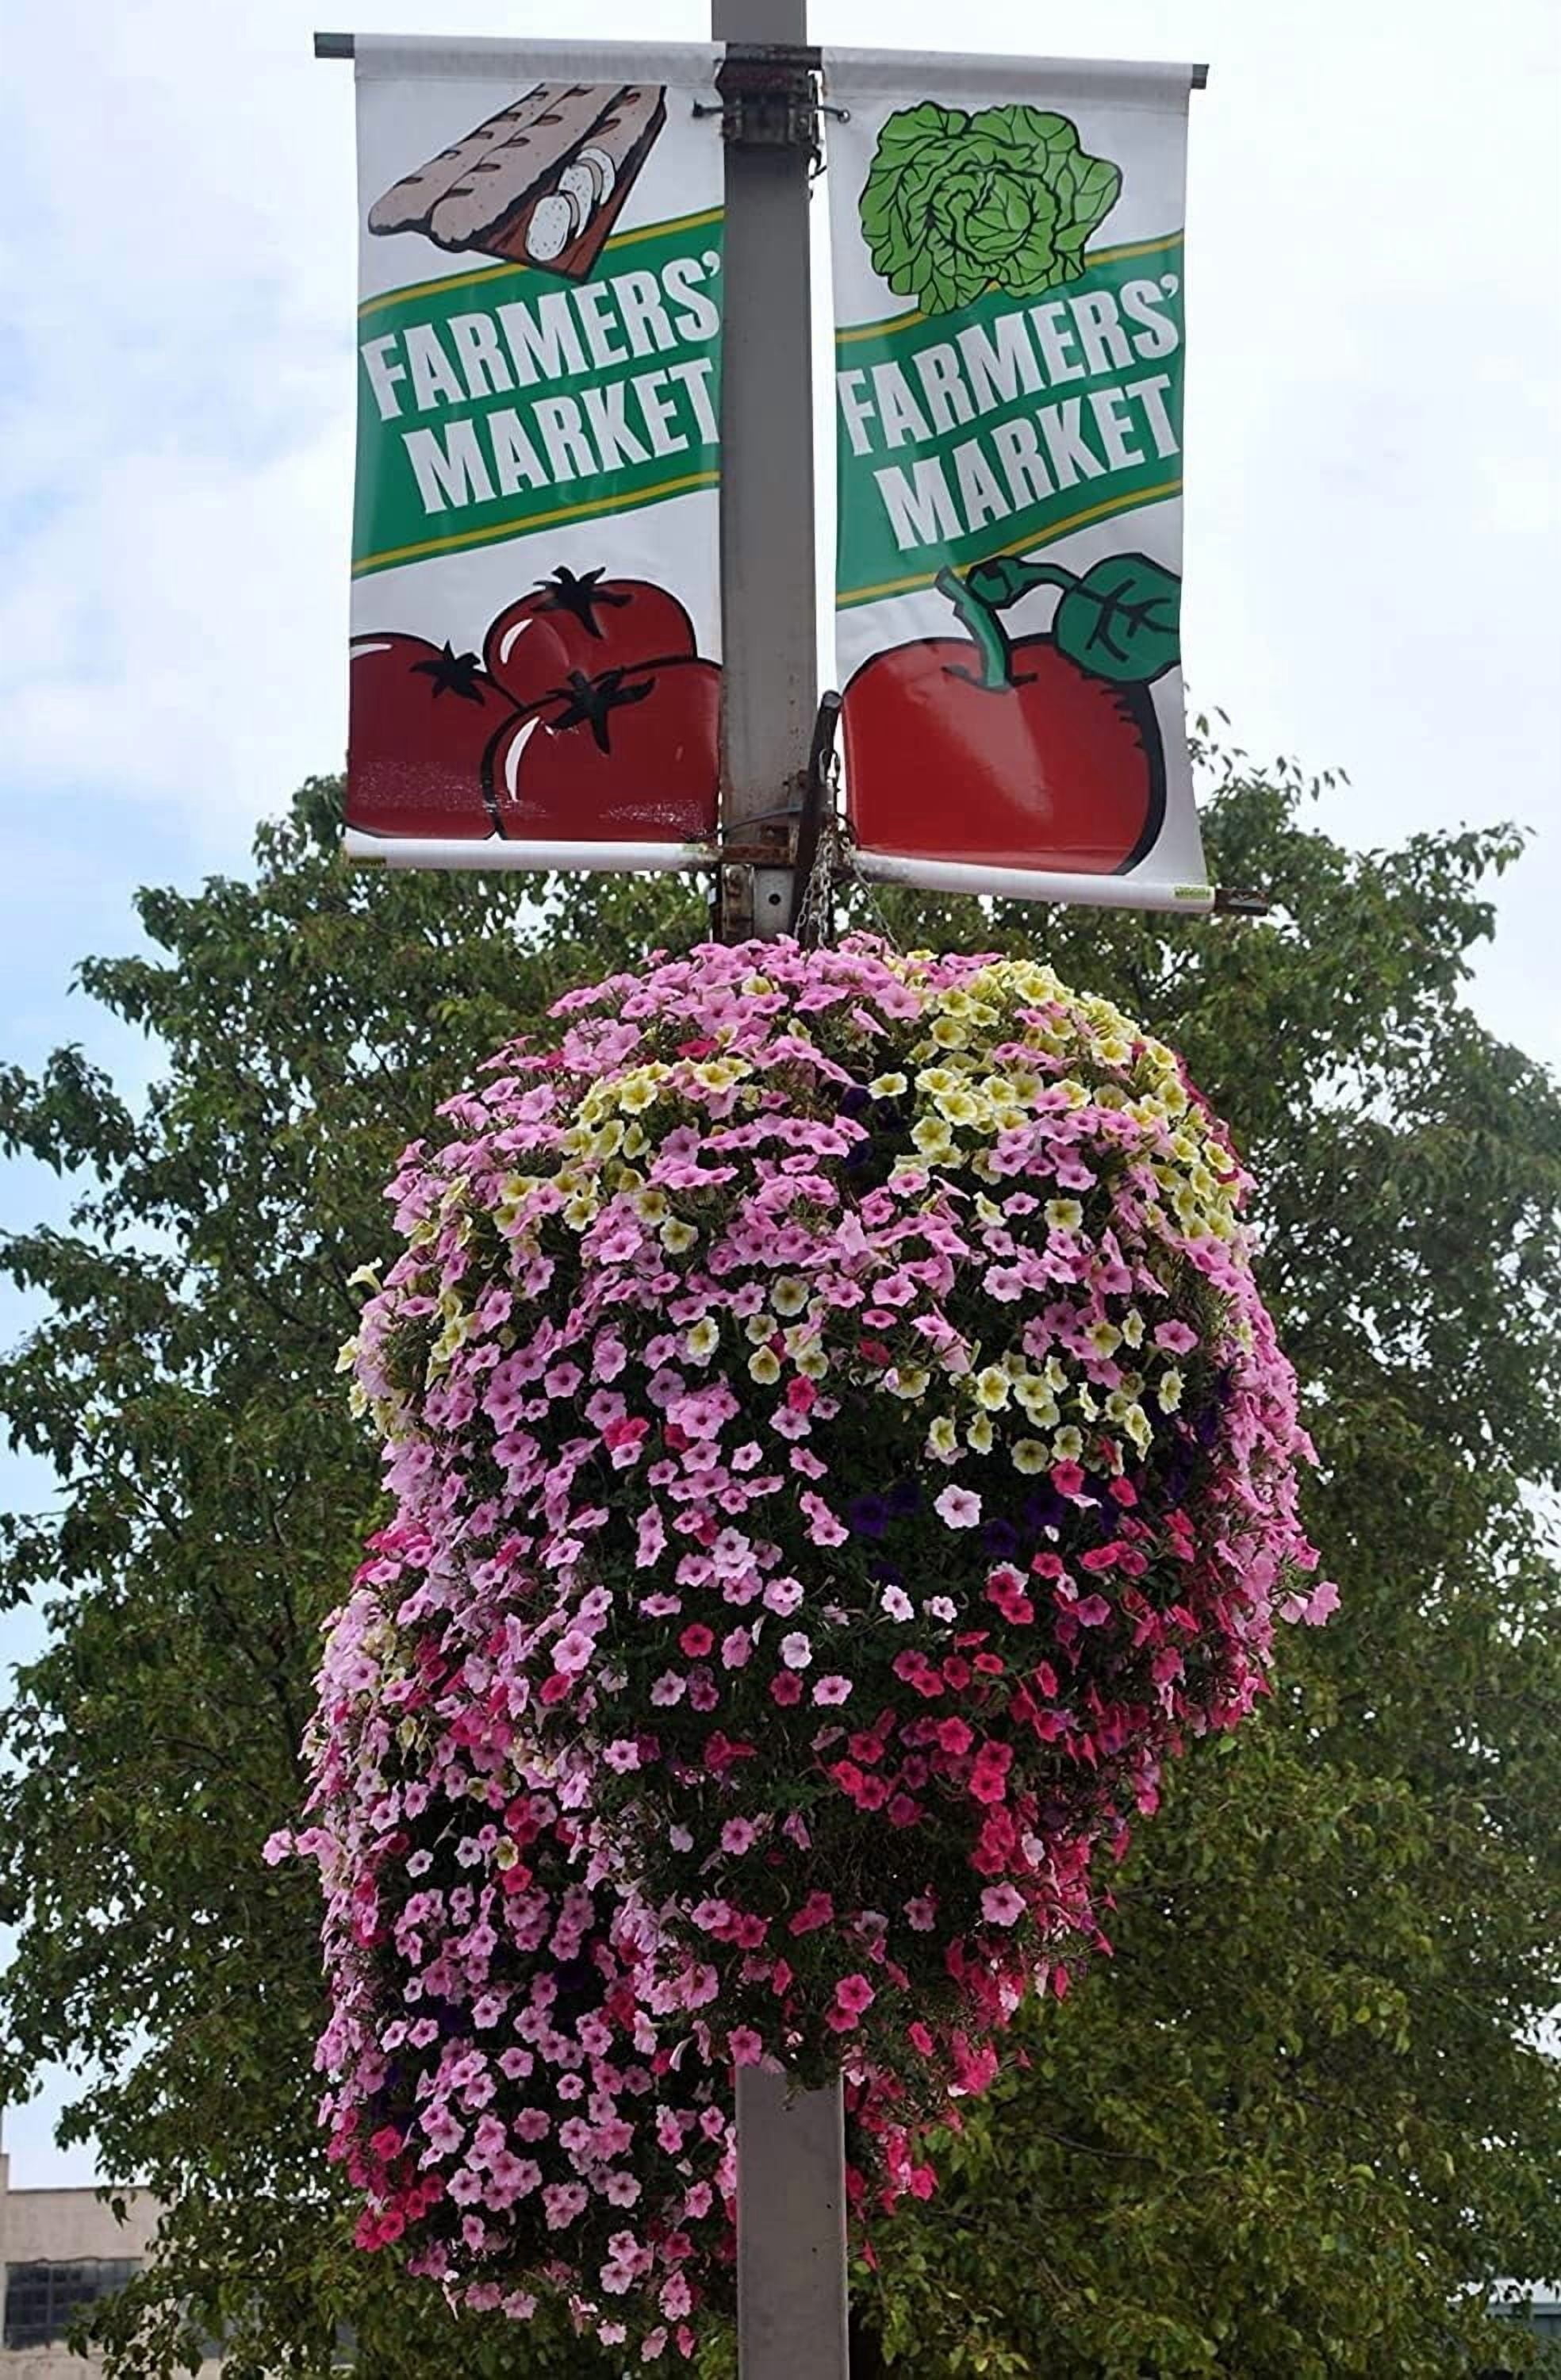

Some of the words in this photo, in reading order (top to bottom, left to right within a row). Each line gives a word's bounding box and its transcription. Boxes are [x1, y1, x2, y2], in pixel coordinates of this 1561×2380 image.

[360, 251, 721, 421] FARMERS'
[836, 274, 1180, 456] FARMERS'
[401, 358, 720, 514] MARKET
[873, 374, 1181, 550] MARKET
